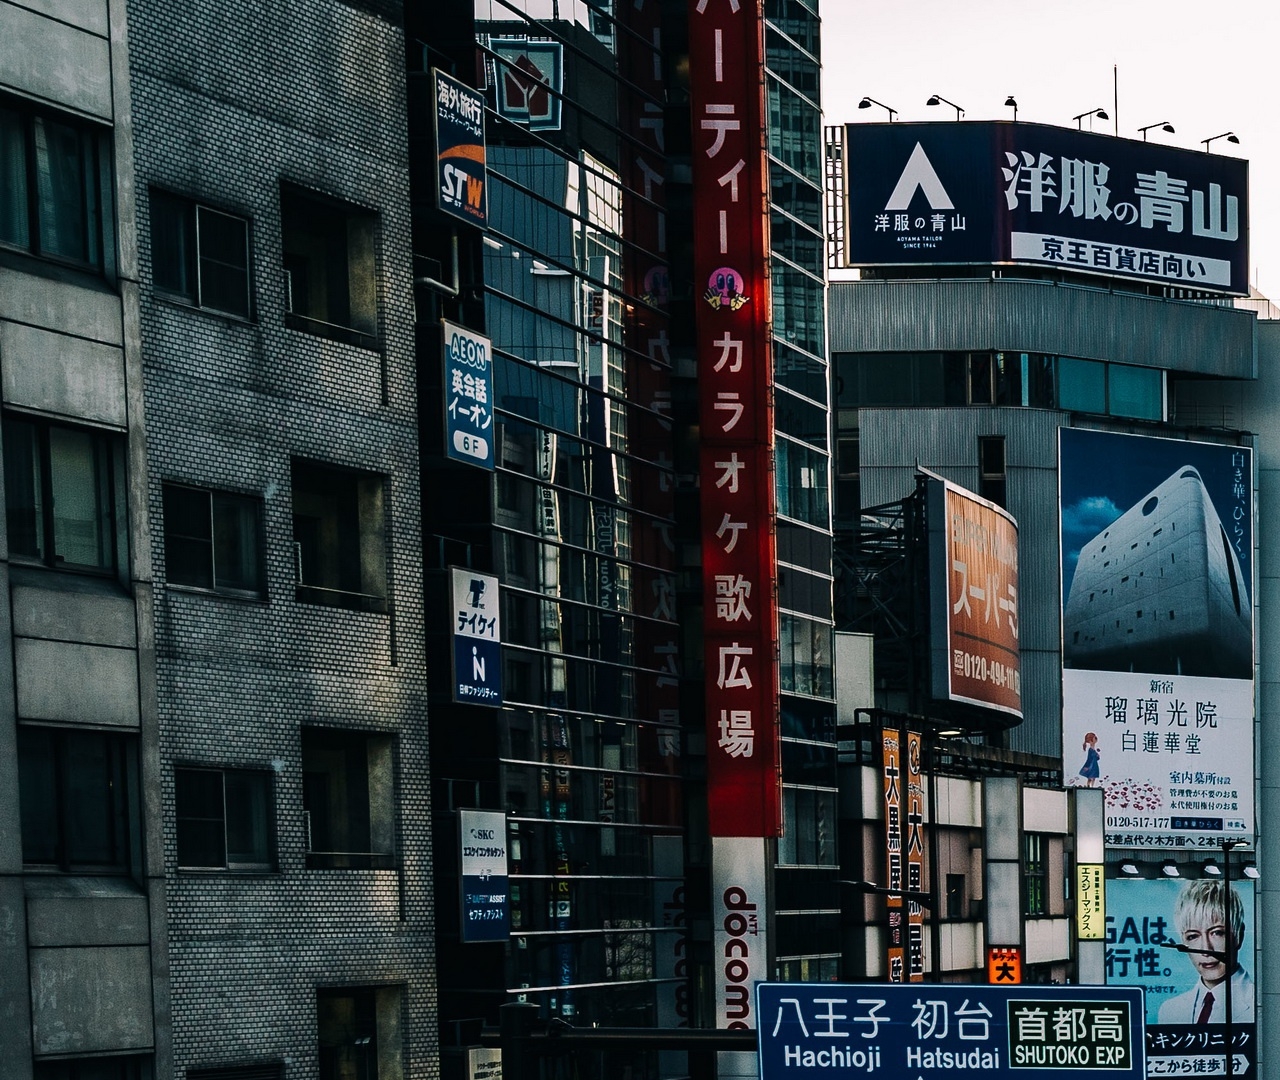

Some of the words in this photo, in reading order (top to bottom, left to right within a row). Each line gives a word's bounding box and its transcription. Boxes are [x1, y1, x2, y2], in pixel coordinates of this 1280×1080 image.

[438, 79, 481, 125] 海外旅行
[441, 163, 483, 209] STW
[1001, 150, 1239, 241] 洋服の青山
[874, 212, 966, 232] 洋服の青山
[1041, 236, 1206, 278] 京王百貨店向い
[451, 334, 486, 369] AEON
[452, 368, 487, 404] 英会話
[448, 397, 492, 430] イーオン
[1231, 451, 1247, 560] 白き華、ひらく。
[711, 332, 756, 759] カラオケ歌広場
[458, 611, 497, 637] テイケイ
[1149, 680, 1174, 695] 新宿
[1105, 696, 1218, 729] 瑠璃光院
[1122, 730, 1202, 755] 白蓮華堂
[1169, 788, 1238, 799] 管理費が不要のお墓
[1169, 800, 1238, 812] 永代使用権付のお墓
[477, 829, 494, 840] SKC
[884, 754, 901, 901] 大黒屋
[1106, 817, 1170, 829] 0120-517-177
[908, 799, 924, 977] 大黒屋
[1081, 867, 1091, 930] エスジーマックス
[748, 914, 758, 936] NTT
[772, 998, 890, 1038] 八王子
[911, 998, 993, 1040] 初台
[1015, 1006, 1123, 1042] 首都高
[1147, 1030, 1250, 1049] キンクリニク
[784, 1045, 881, 1071] Hachioji
[906, 1046, 1000, 1069] Hatsudai
[1015, 1045, 1089, 1065] SHUTOKO
[1096, 1046, 1125, 1066] EXP
